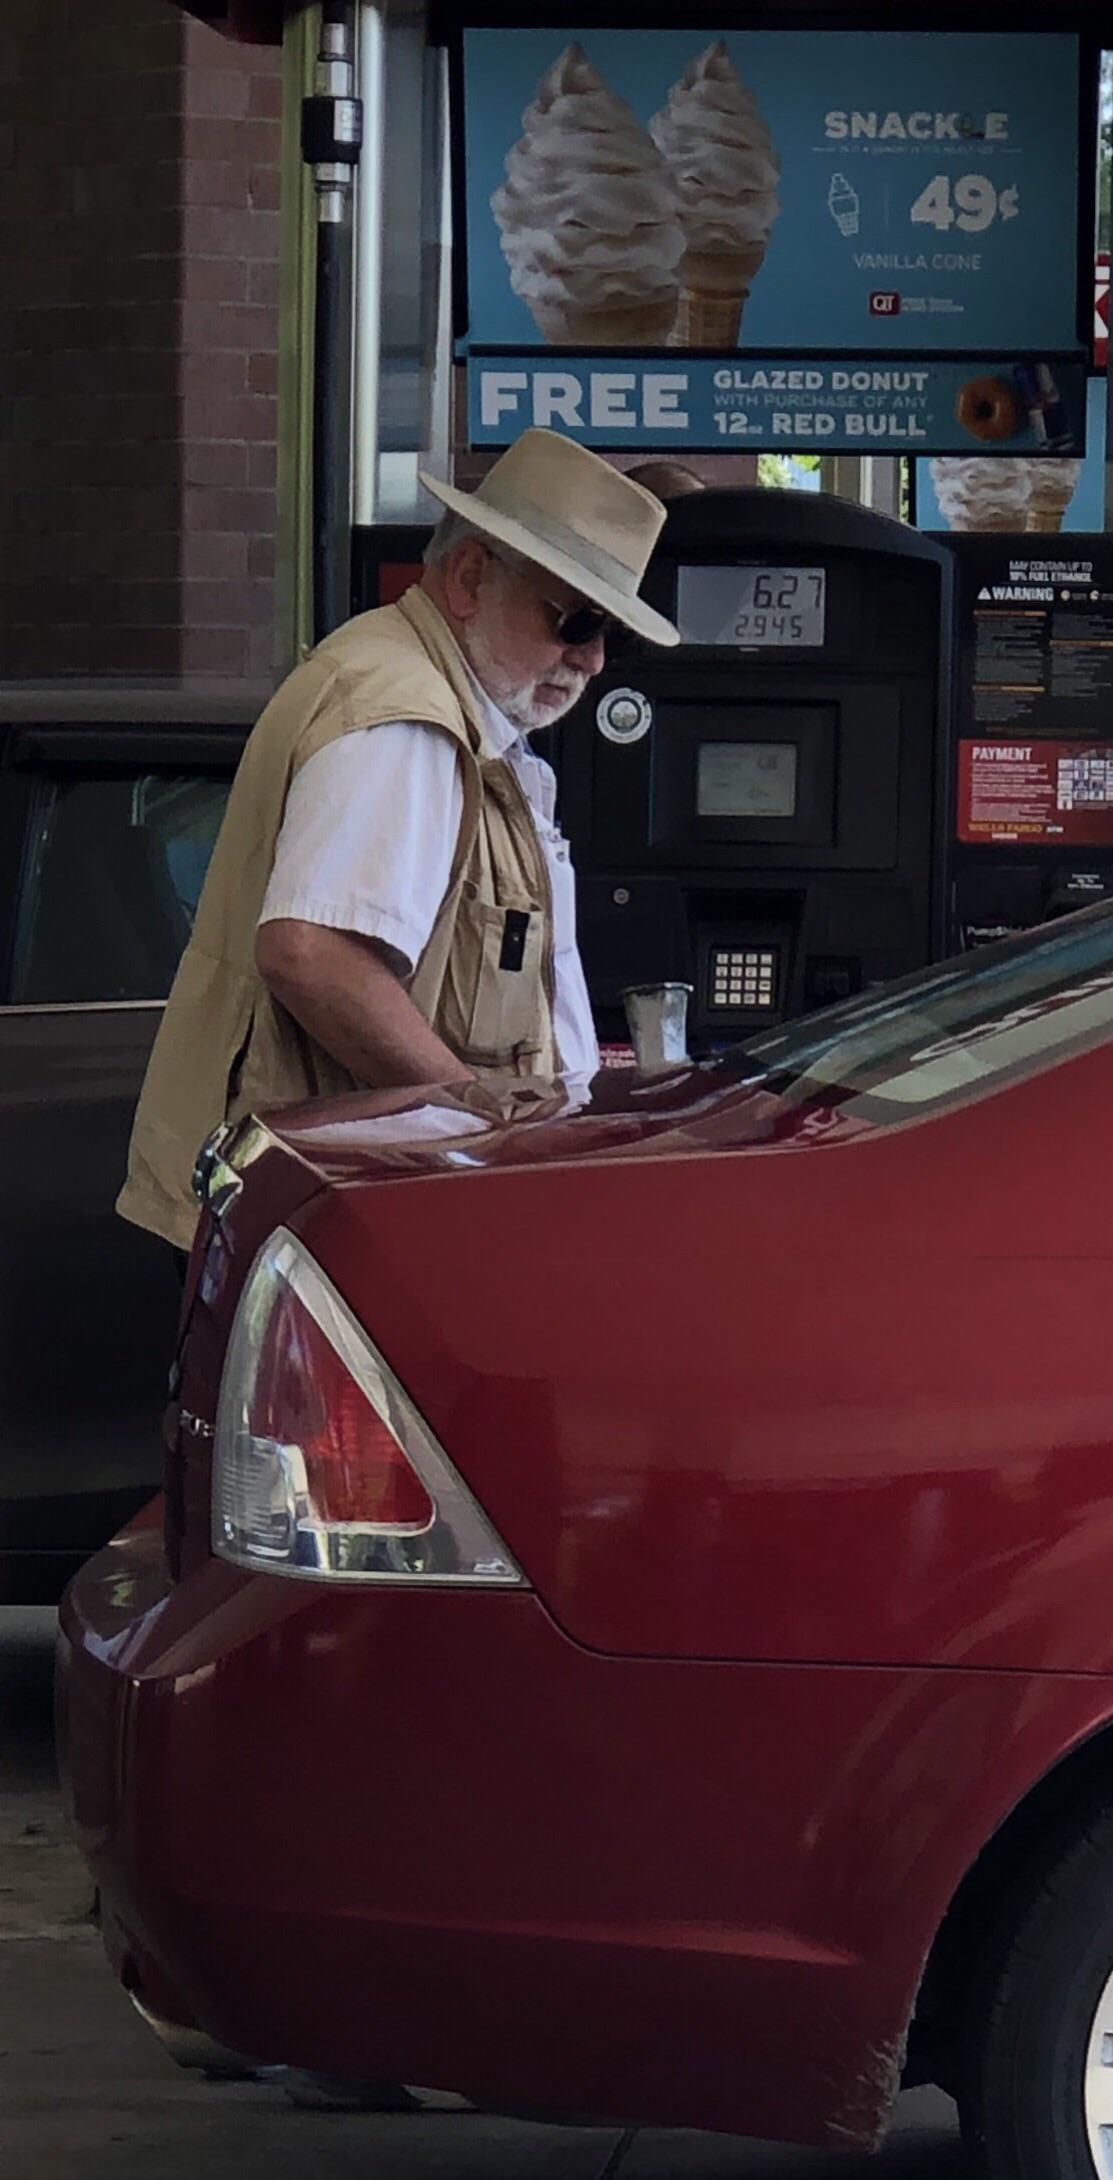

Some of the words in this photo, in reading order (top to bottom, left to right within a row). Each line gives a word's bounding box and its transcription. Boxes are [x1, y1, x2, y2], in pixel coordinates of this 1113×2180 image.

[853, 253, 928, 269] VANILLA
[932, 253, 982, 270] CONE
[713, 370, 824, 391] GLAZED
[831, 371, 929, 392] DONUT
[480, 372, 689, 428] FREE
[713, 394, 758, 407] WITH
[764, 394, 856, 408] PURCHASE
[863, 396, 887, 408] OF
[893, 396, 928, 409] ANY
[772, 413, 836, 436] RED
[845, 414, 927, 437] BULL
[992, 586, 1054, 601] WARNING
[972, 746, 1032, 761] PAYMENT
